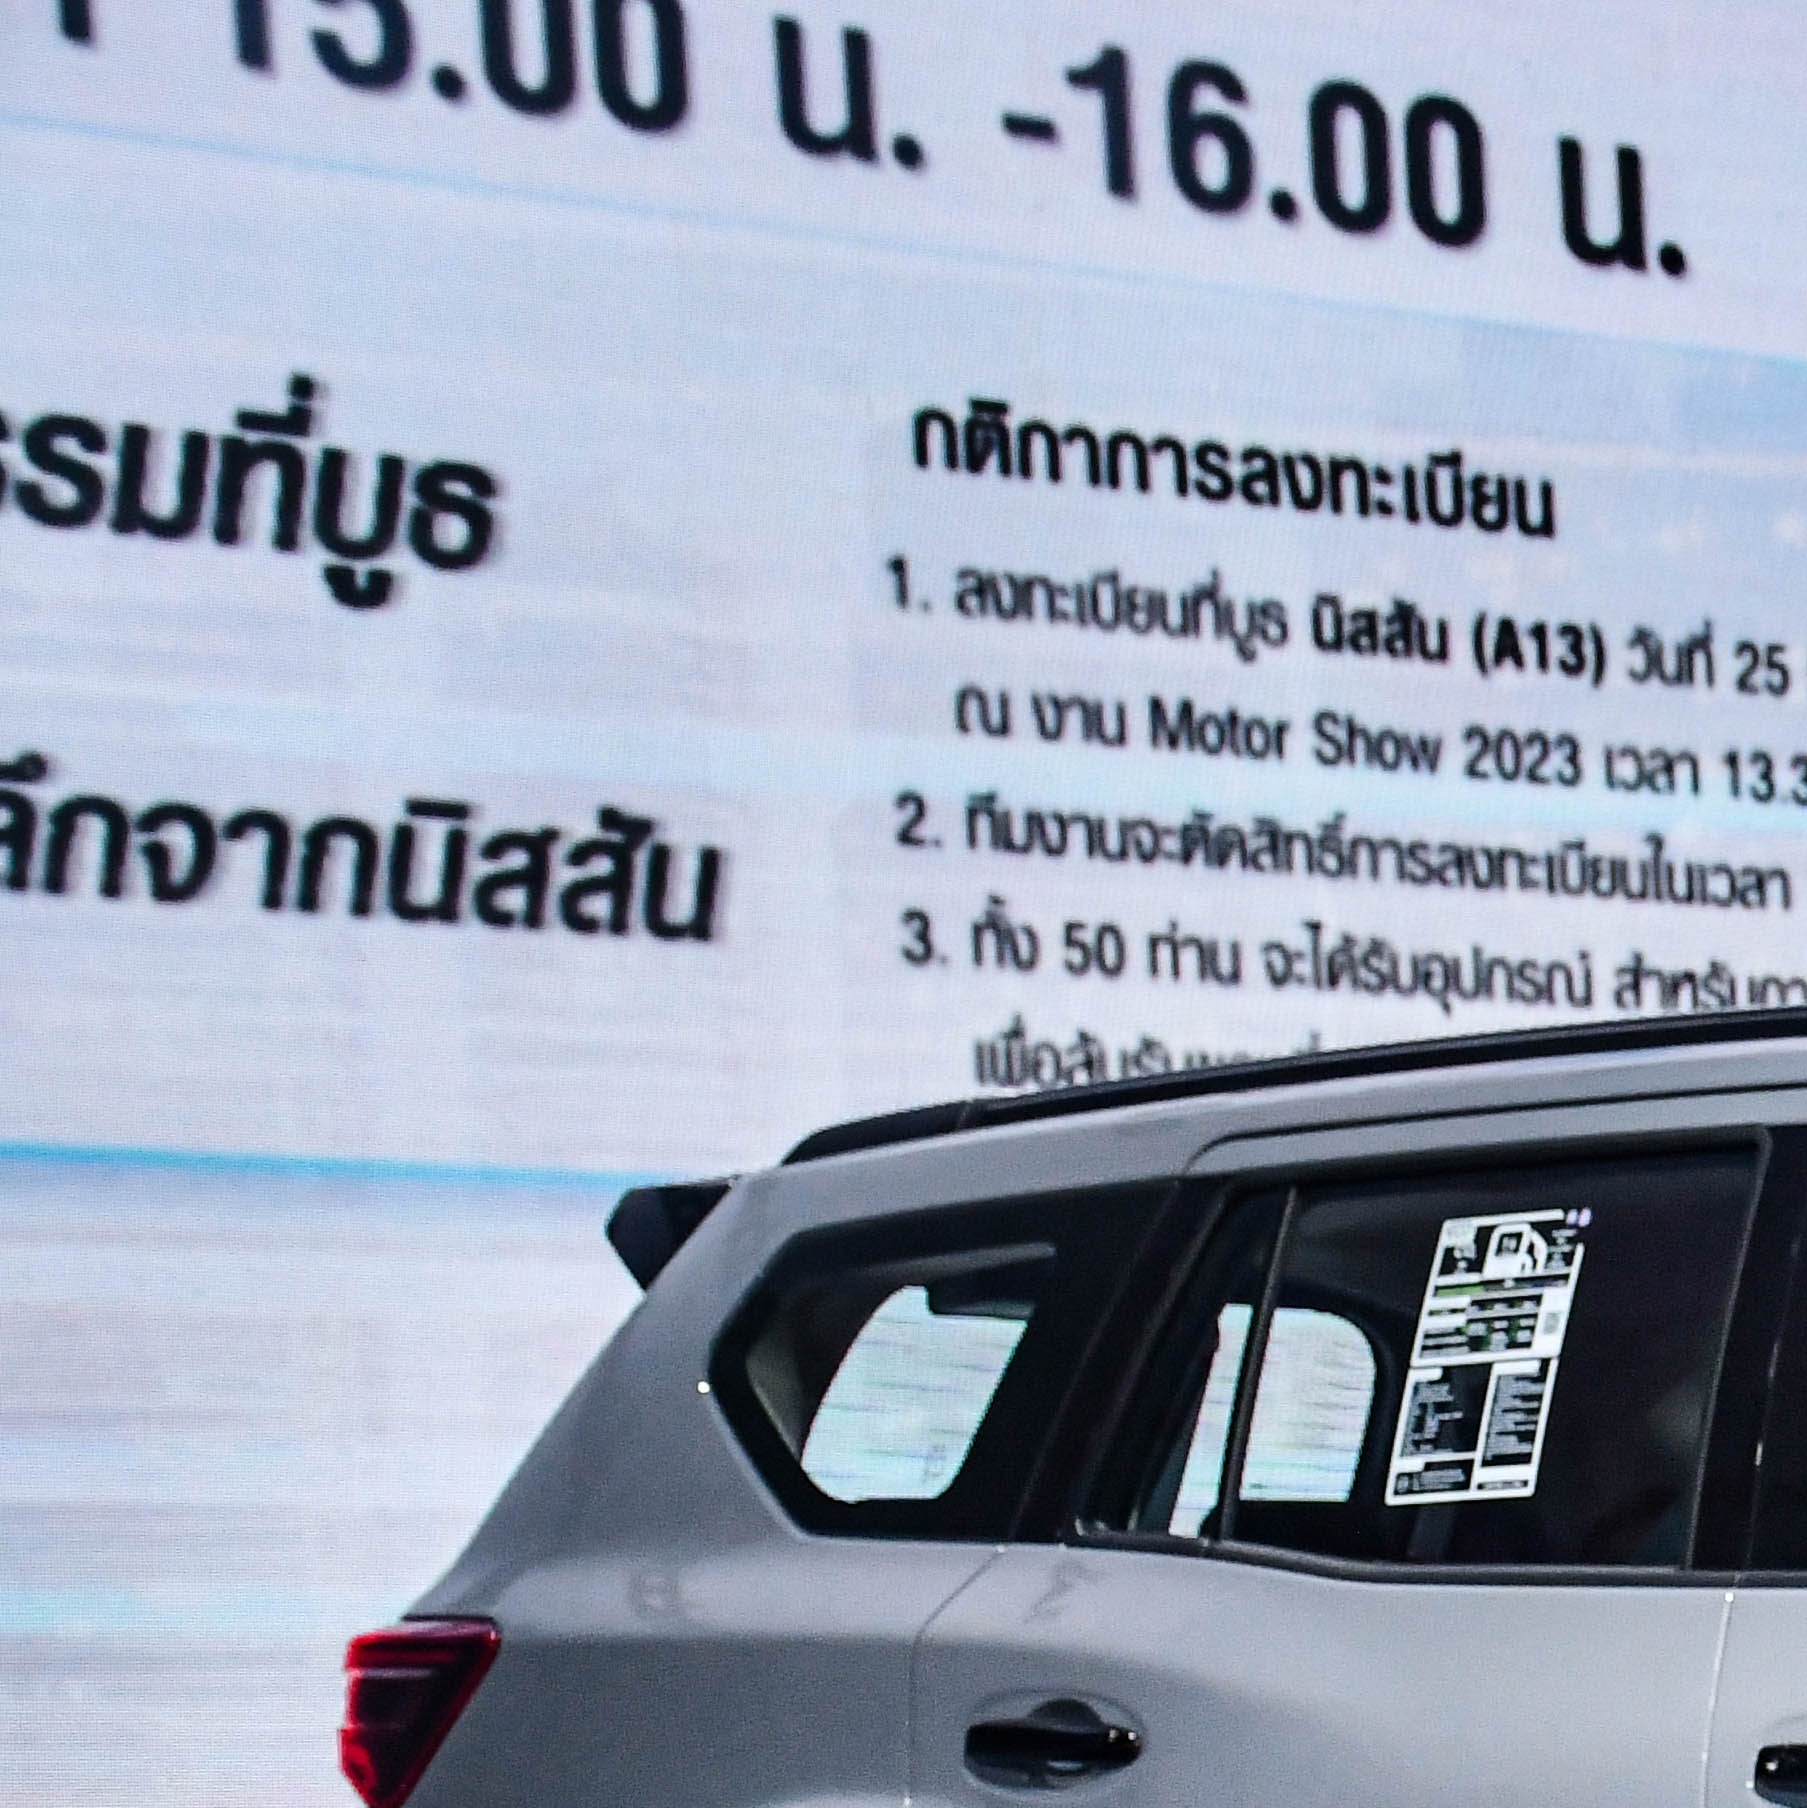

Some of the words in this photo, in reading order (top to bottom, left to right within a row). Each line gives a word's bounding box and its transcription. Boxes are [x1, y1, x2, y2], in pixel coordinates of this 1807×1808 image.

[774, 15, 924, 171] น.
[1559, 135, 1686, 277] น.
[0, 373, 497, 607] รมที่บูธ
[911, 397, 1556, 537] กติกาการลงทะเบียน
[956, 567, 1289, 663] ลงทะเบียนที่บูธ
[1311, 596, 1448, 663] นิสสัน
[1473, 612, 1606, 688] (A13)
[1627, 620, 1716, 690] วันที่
[1734, 640, 1790, 697] 25
[1030, 690, 1126, 747] งาน
[1149, 695, 1291, 760] Motor
[1312, 710, 1443, 774] Show
[1463, 724, 1582, 787] 2023
[1605, 744, 1700, 795] เวลา
[895, 790, 943, 847] 2.
[901, 909, 948, 966] 3.
[971, 894, 1040, 972] ทั้ง
[1064, 919, 1125, 977] 50
[1148, 918, 1242, 986] ท่าน
